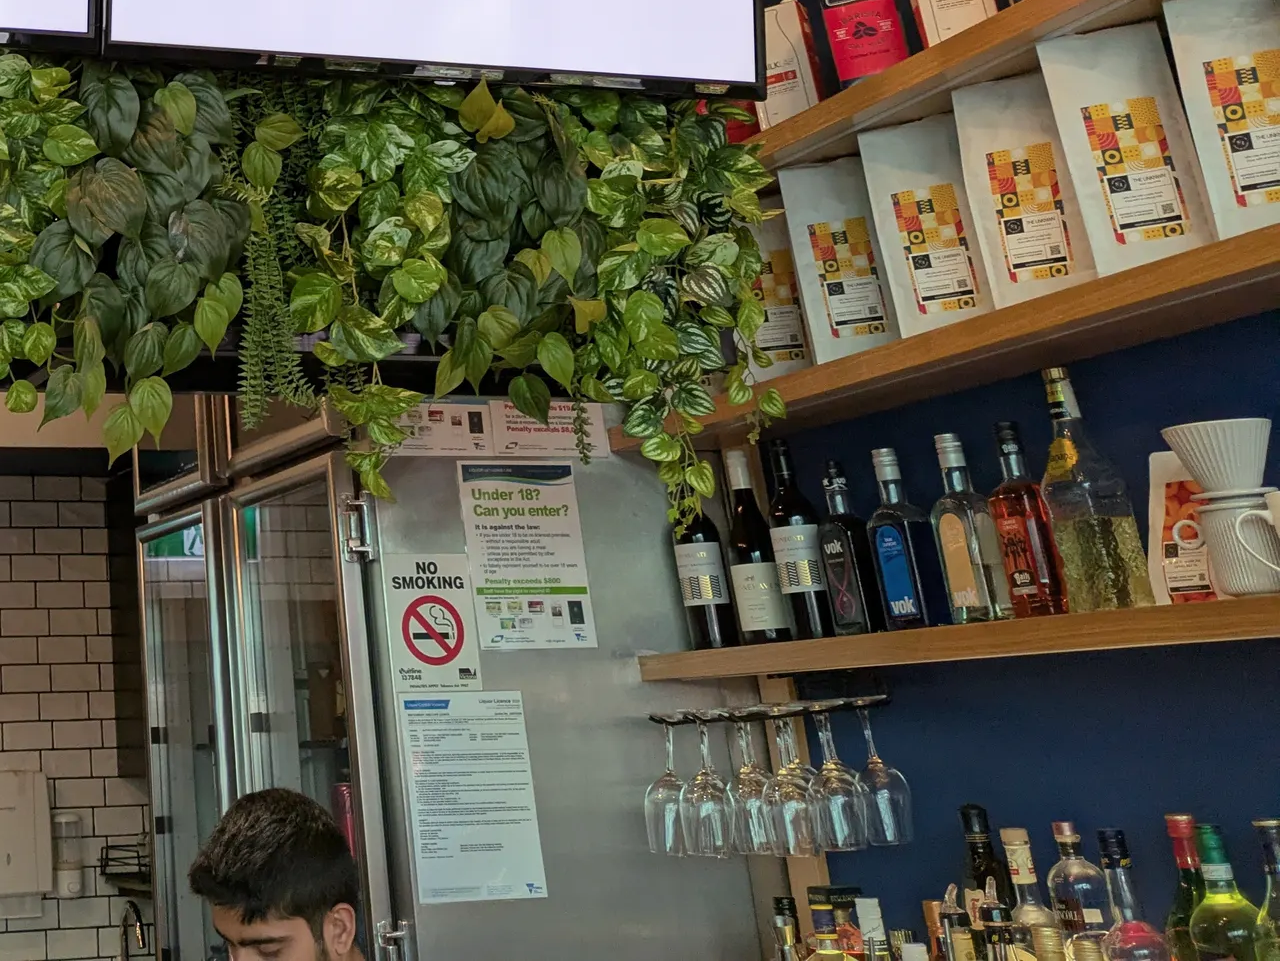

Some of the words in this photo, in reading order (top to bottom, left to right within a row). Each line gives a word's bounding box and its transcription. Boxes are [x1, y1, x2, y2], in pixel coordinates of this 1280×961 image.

[507, 426, 532, 434] Penalty
[471, 488, 514, 501] Under
[518, 488, 540, 501] 18?
[473, 504, 499, 517] Can
[502, 507, 525, 519] you
[528, 504, 569, 517] enter?
[415, 561, 438, 575] NO
[391, 576, 464, 590] SMOKING
